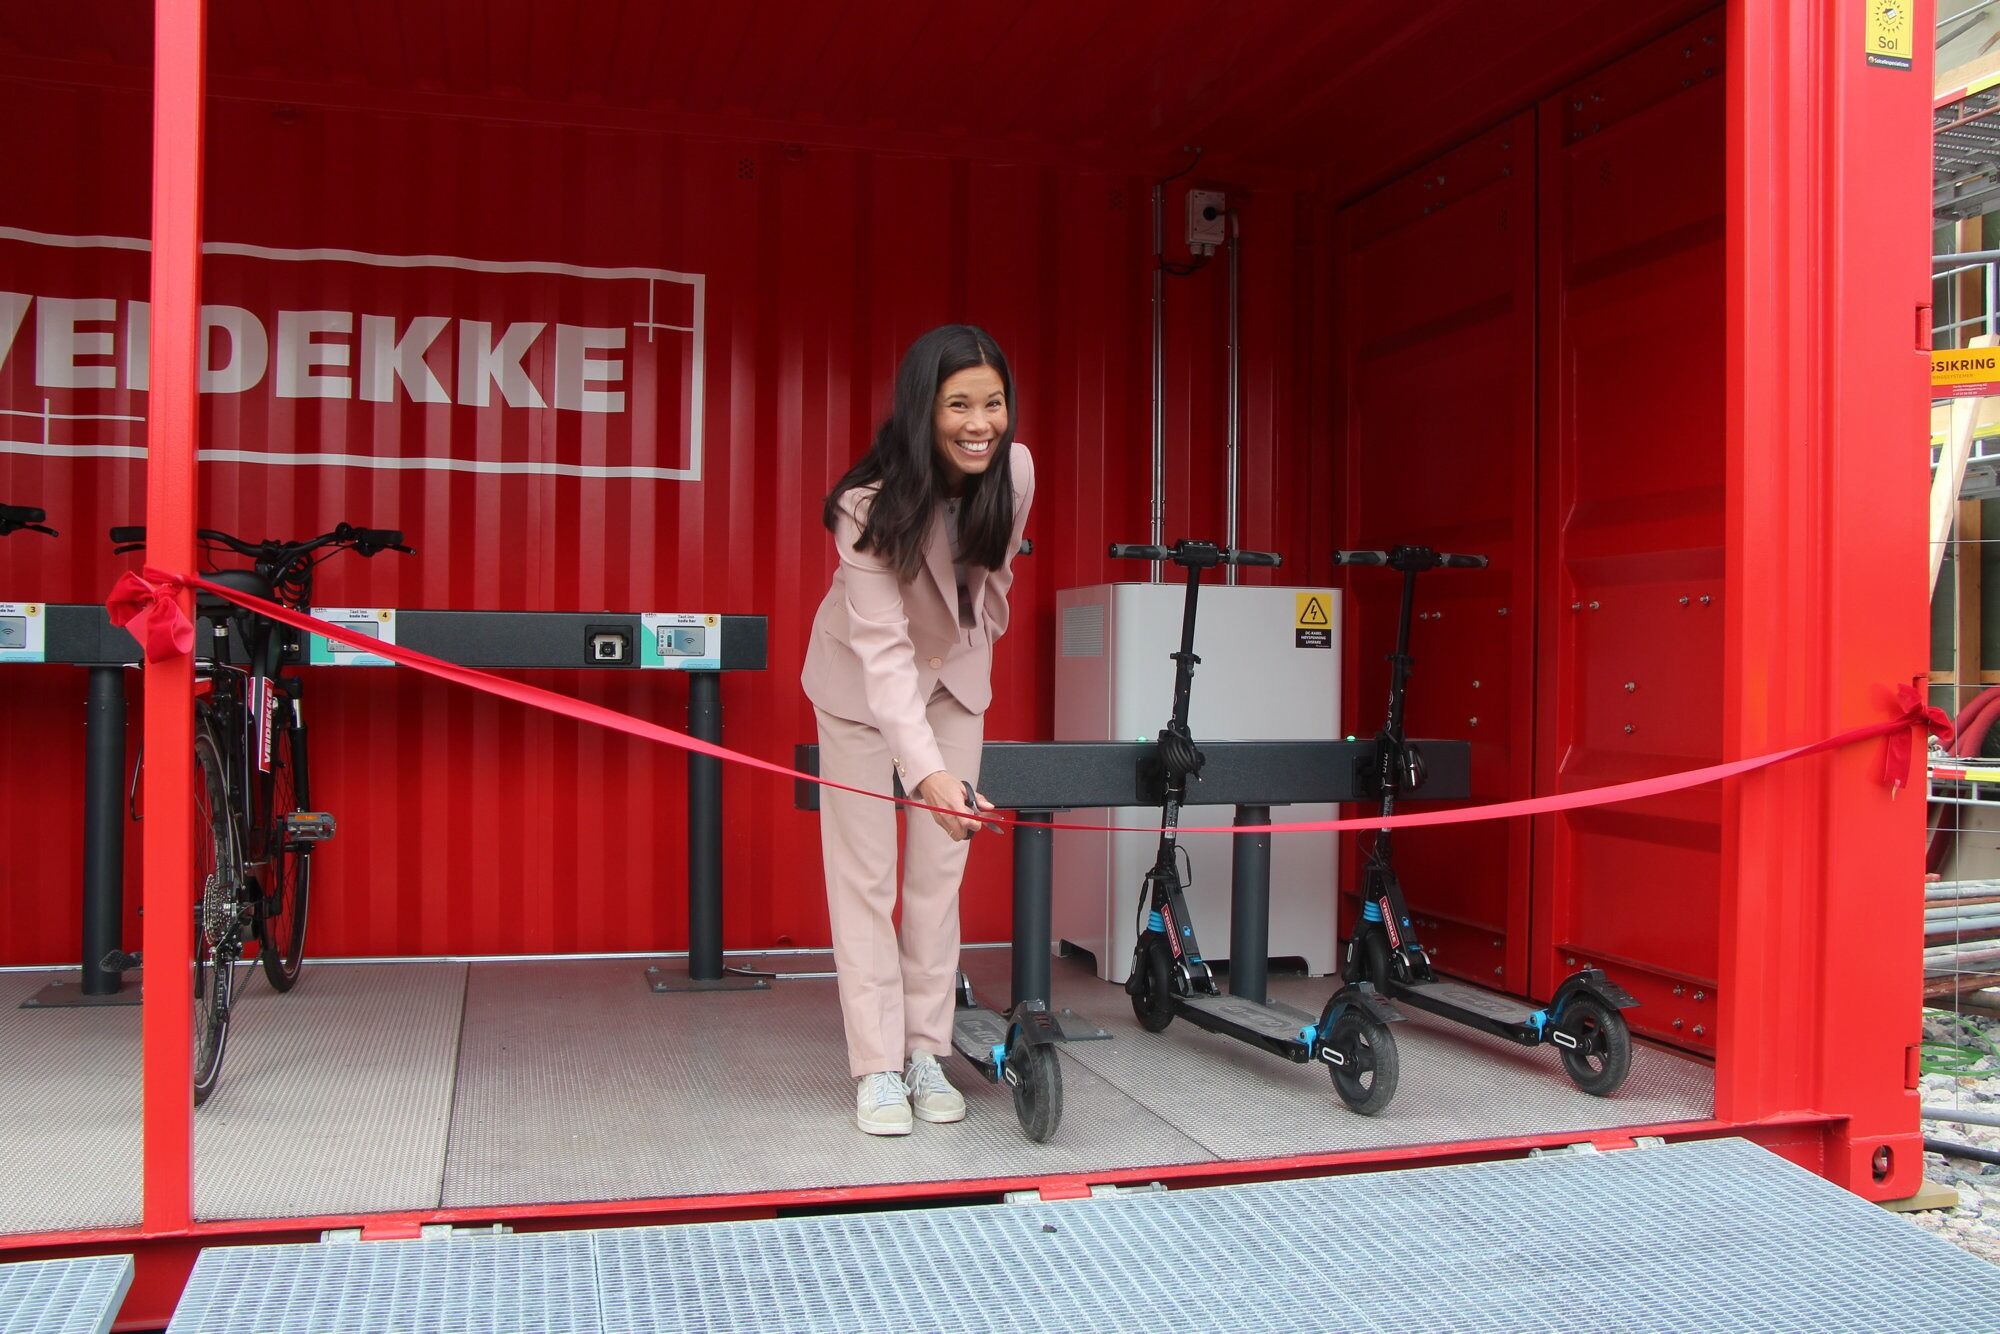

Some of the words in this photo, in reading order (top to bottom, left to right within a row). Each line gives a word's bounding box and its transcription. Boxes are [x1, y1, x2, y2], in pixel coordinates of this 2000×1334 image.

[1878, 36, 1898, 50] Sol
[264, 688, 273, 763] VEIDEKKE
[1163, 910, 1178, 952] VEIDEKKE
[1382, 902, 1396, 942] VEIDEKKE
